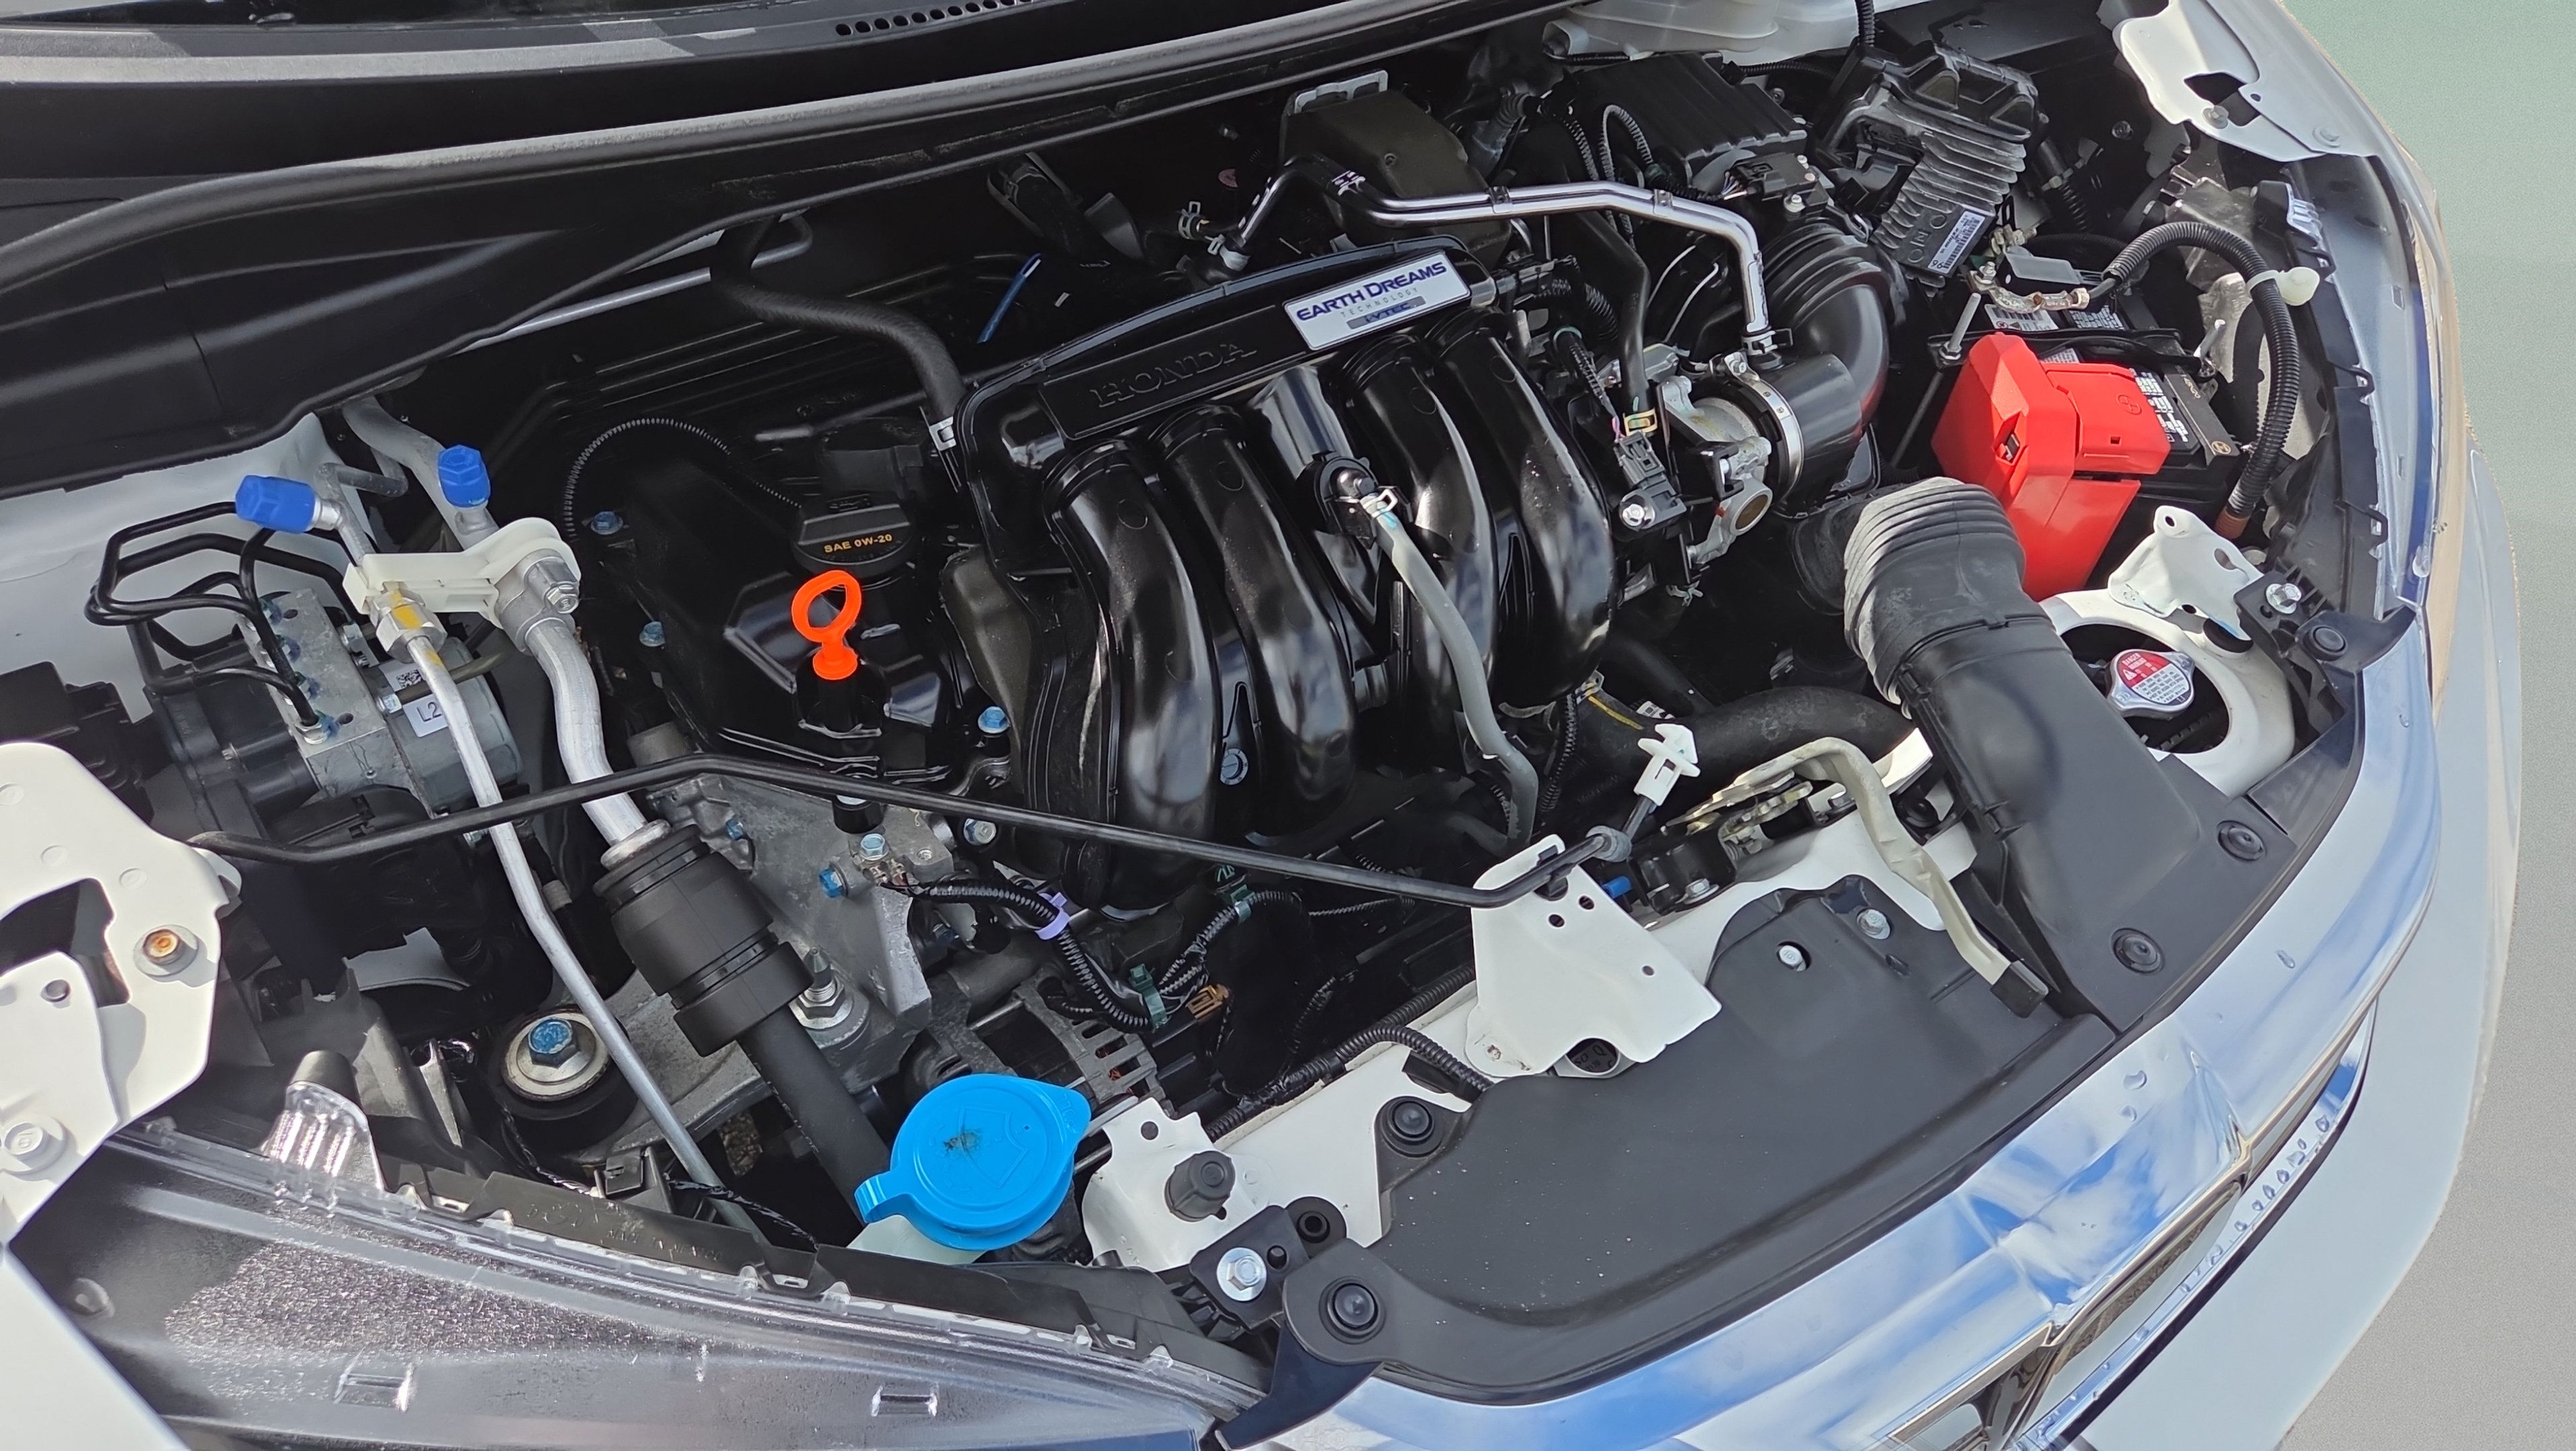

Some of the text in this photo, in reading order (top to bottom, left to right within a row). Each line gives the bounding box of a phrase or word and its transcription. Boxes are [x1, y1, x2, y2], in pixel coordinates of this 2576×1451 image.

[1296, 261, 1447, 321] EARTH DREAMS
[1340, 286, 1419, 318] TECHNOLOGY
[1089, 343, 1258, 408] HONDA
[823, 541, 852, 554] SAE
[854, 533, 893, 548] 0W-20
[416, 701, 443, 723] L2
